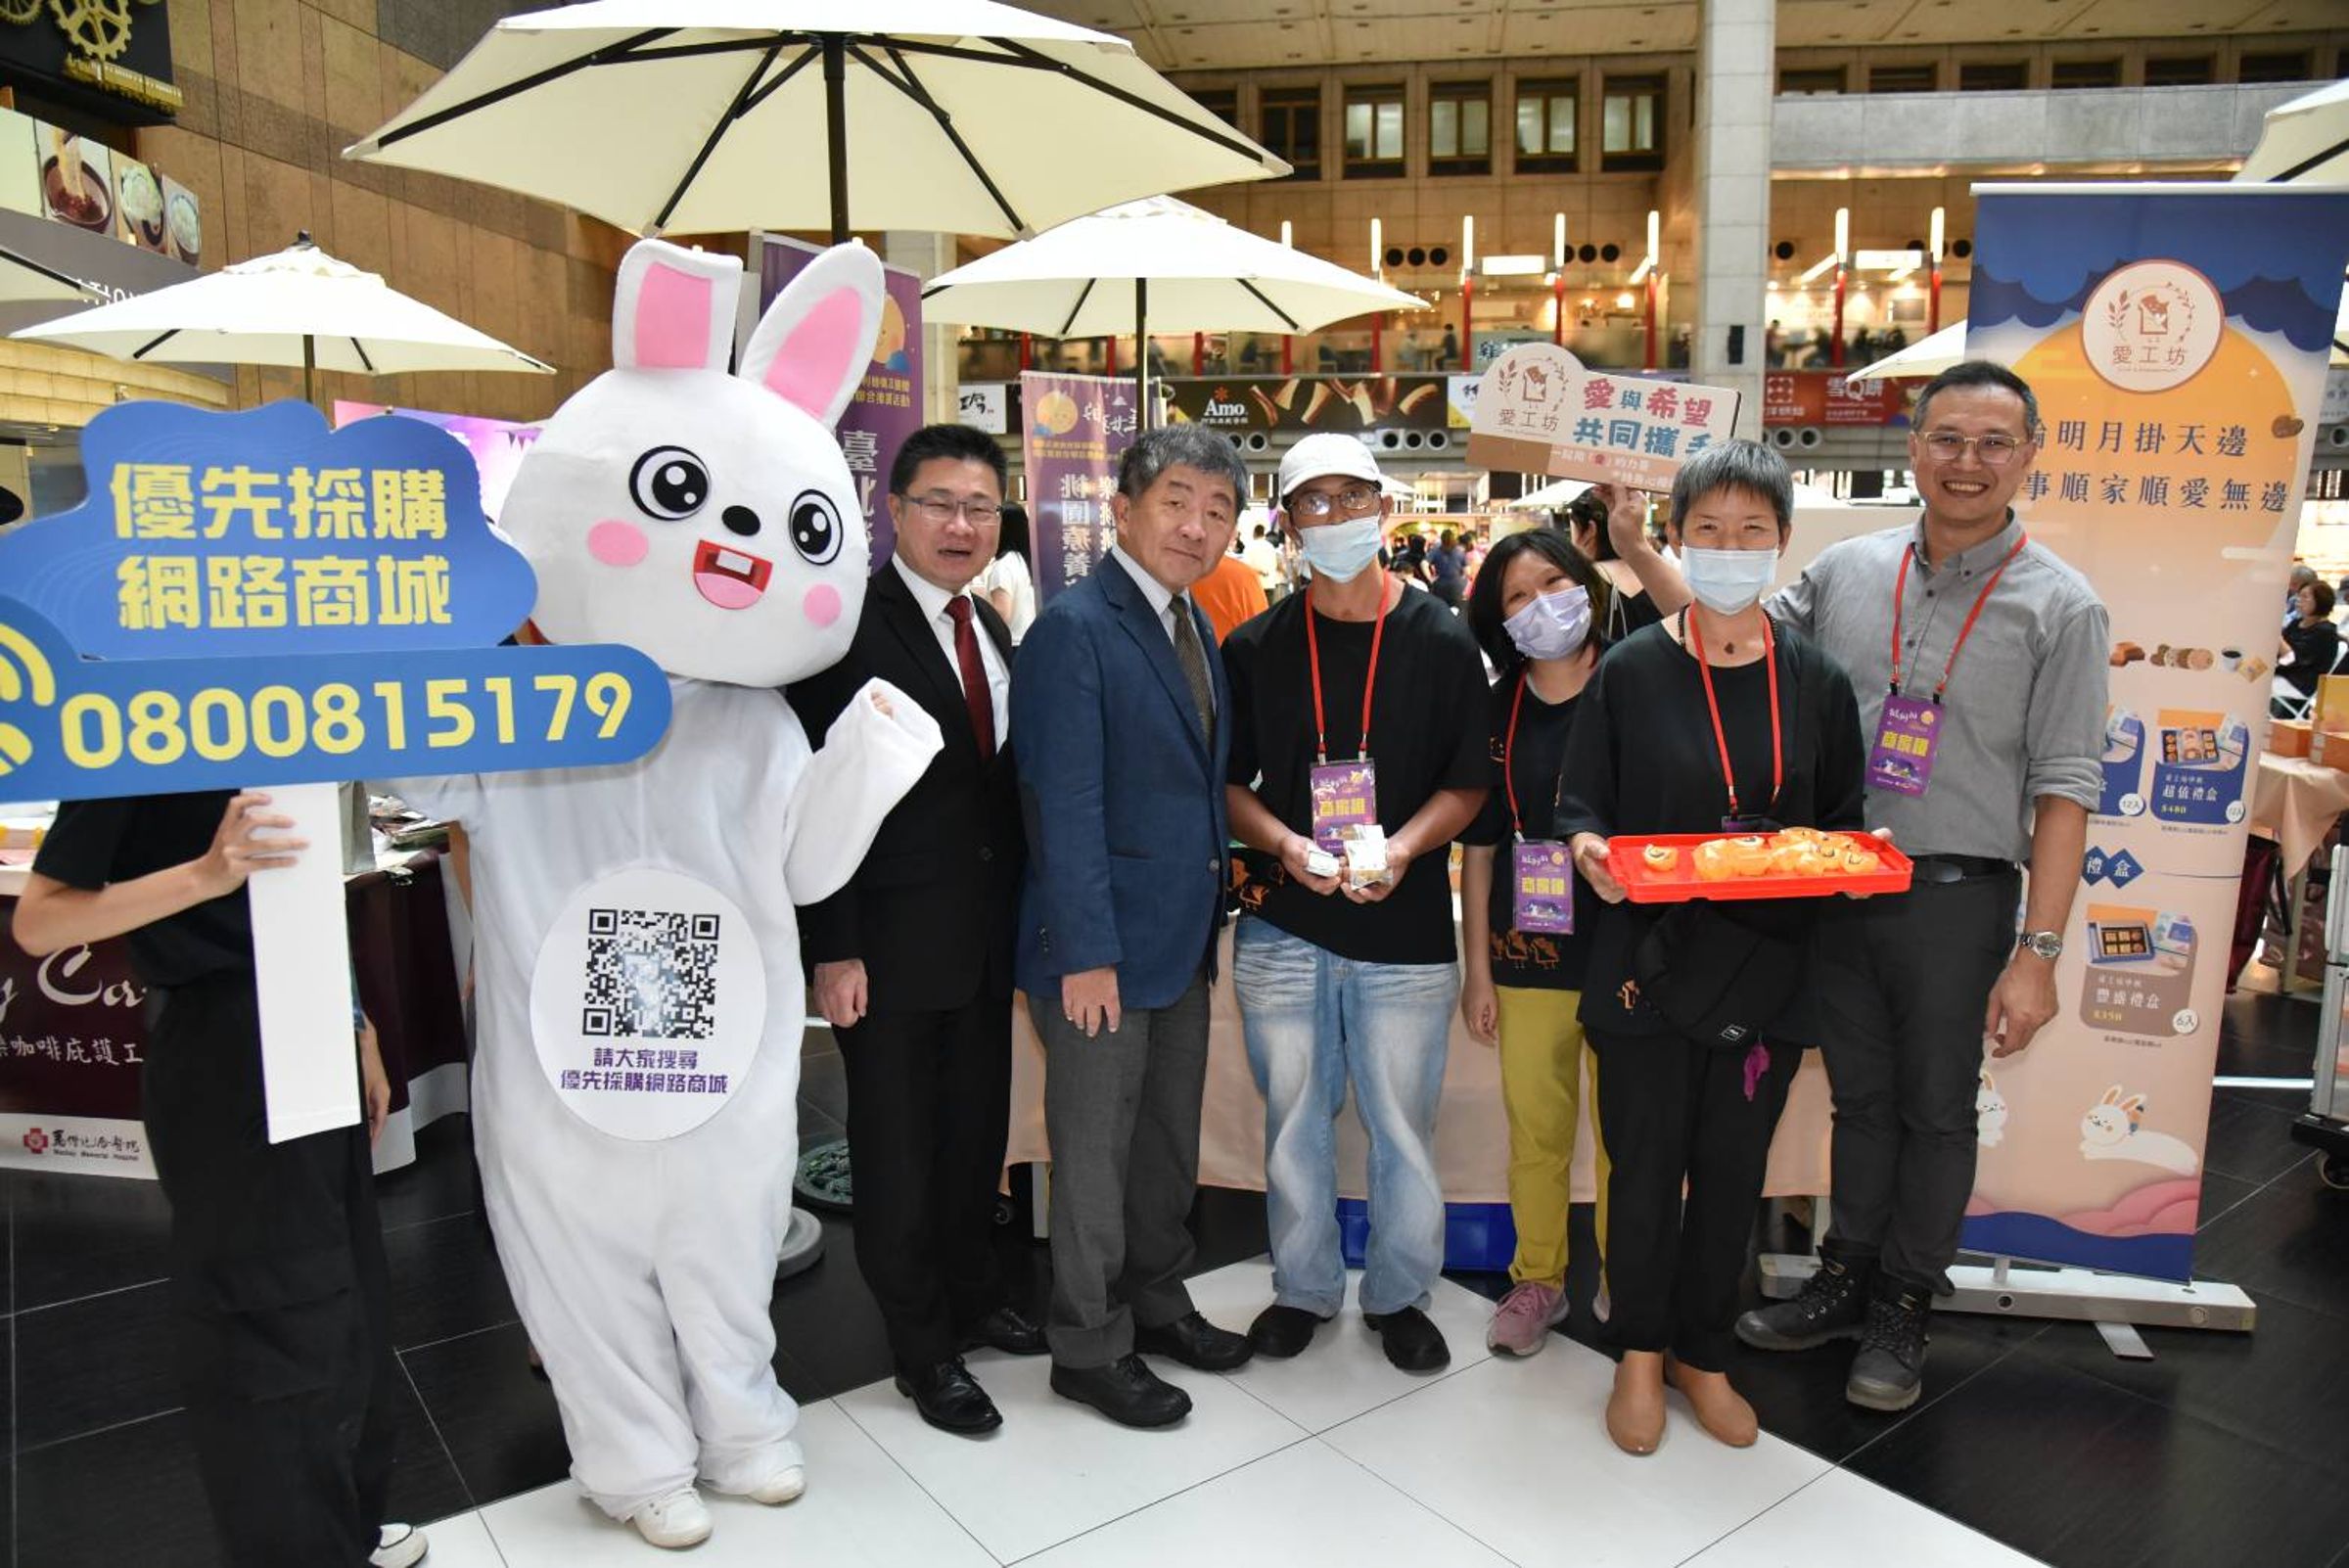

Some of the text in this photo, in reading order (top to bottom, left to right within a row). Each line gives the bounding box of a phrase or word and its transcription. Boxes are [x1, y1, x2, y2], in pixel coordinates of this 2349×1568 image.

[2112, 345, 2188, 366] 愛工坊
[1204, 397, 1246, 417] Amo
[1583, 377, 1713, 428] 愛與希望
[1495, 407, 1560, 433] 愛工坊
[110, 463, 449, 541] 優先採購
[115, 554, 454, 631] 網路商城
[60, 671, 633, 770] 0800815179
[2162, 784, 2219, 802] 超值禮盒
[593, 1047, 698, 1070] 請大家搜尋
[561, 1069, 728, 1094] 優先採購網路商城
